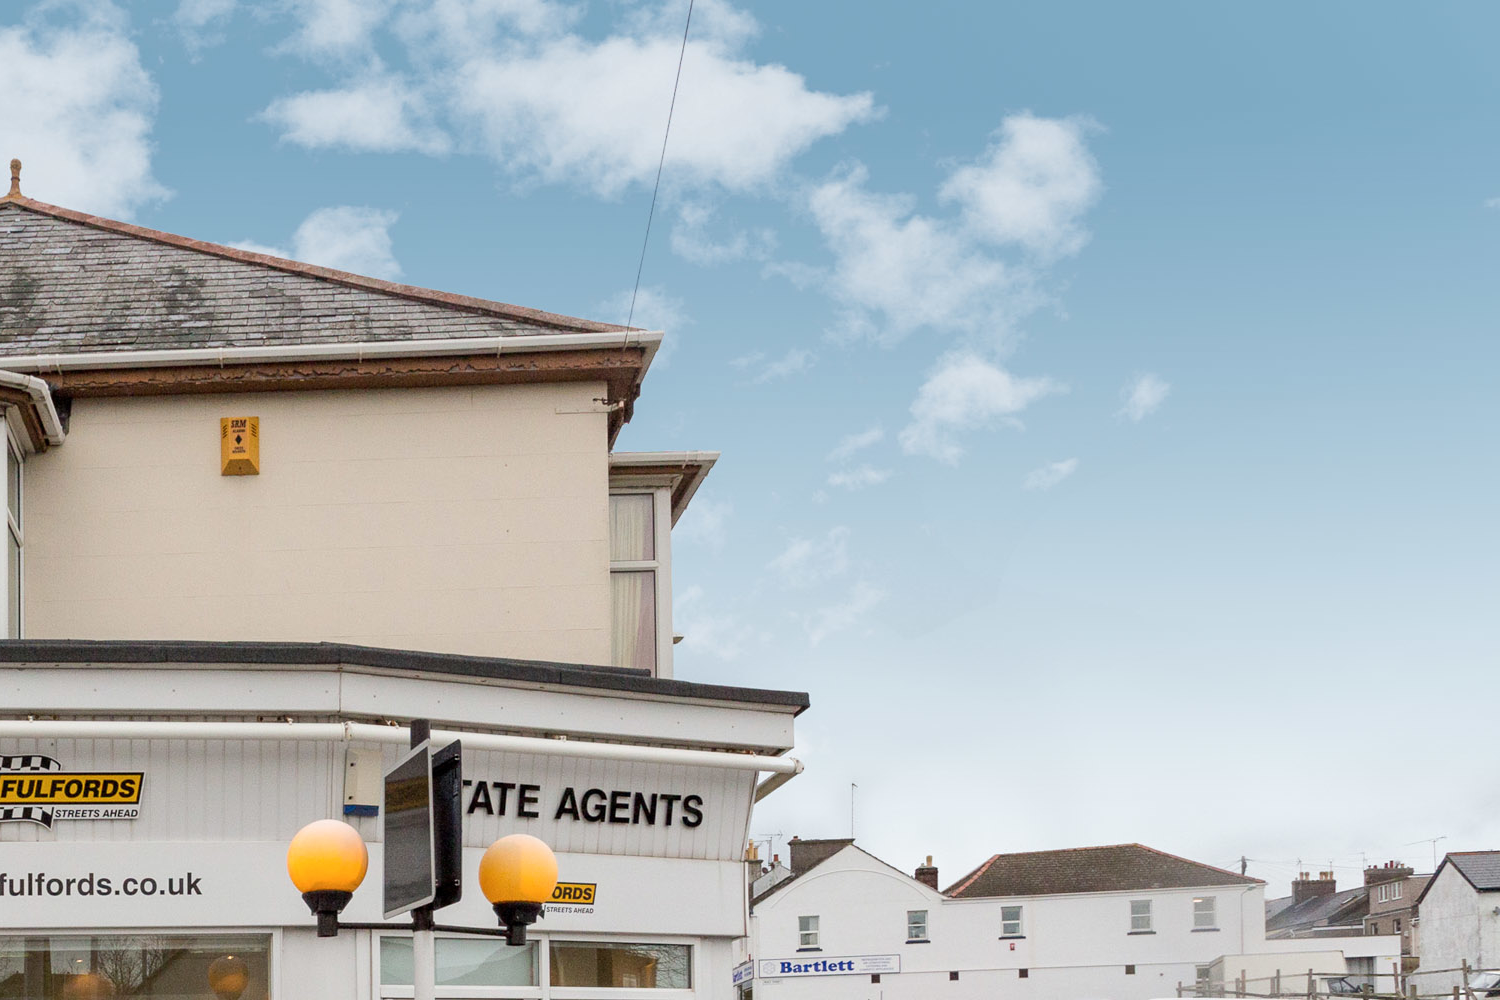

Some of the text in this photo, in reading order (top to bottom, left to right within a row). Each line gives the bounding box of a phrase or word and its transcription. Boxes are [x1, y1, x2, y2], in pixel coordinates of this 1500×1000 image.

[0, 779, 136, 799] FULFORDS
[55, 809, 138, 818] STREETS AHEAD
[555, 787, 704, 827] AGENTS
[552, 886, 593, 901] ORDS
[546, 906, 573, 914] STREETS
[780, 960, 855, 974] Bartlett
